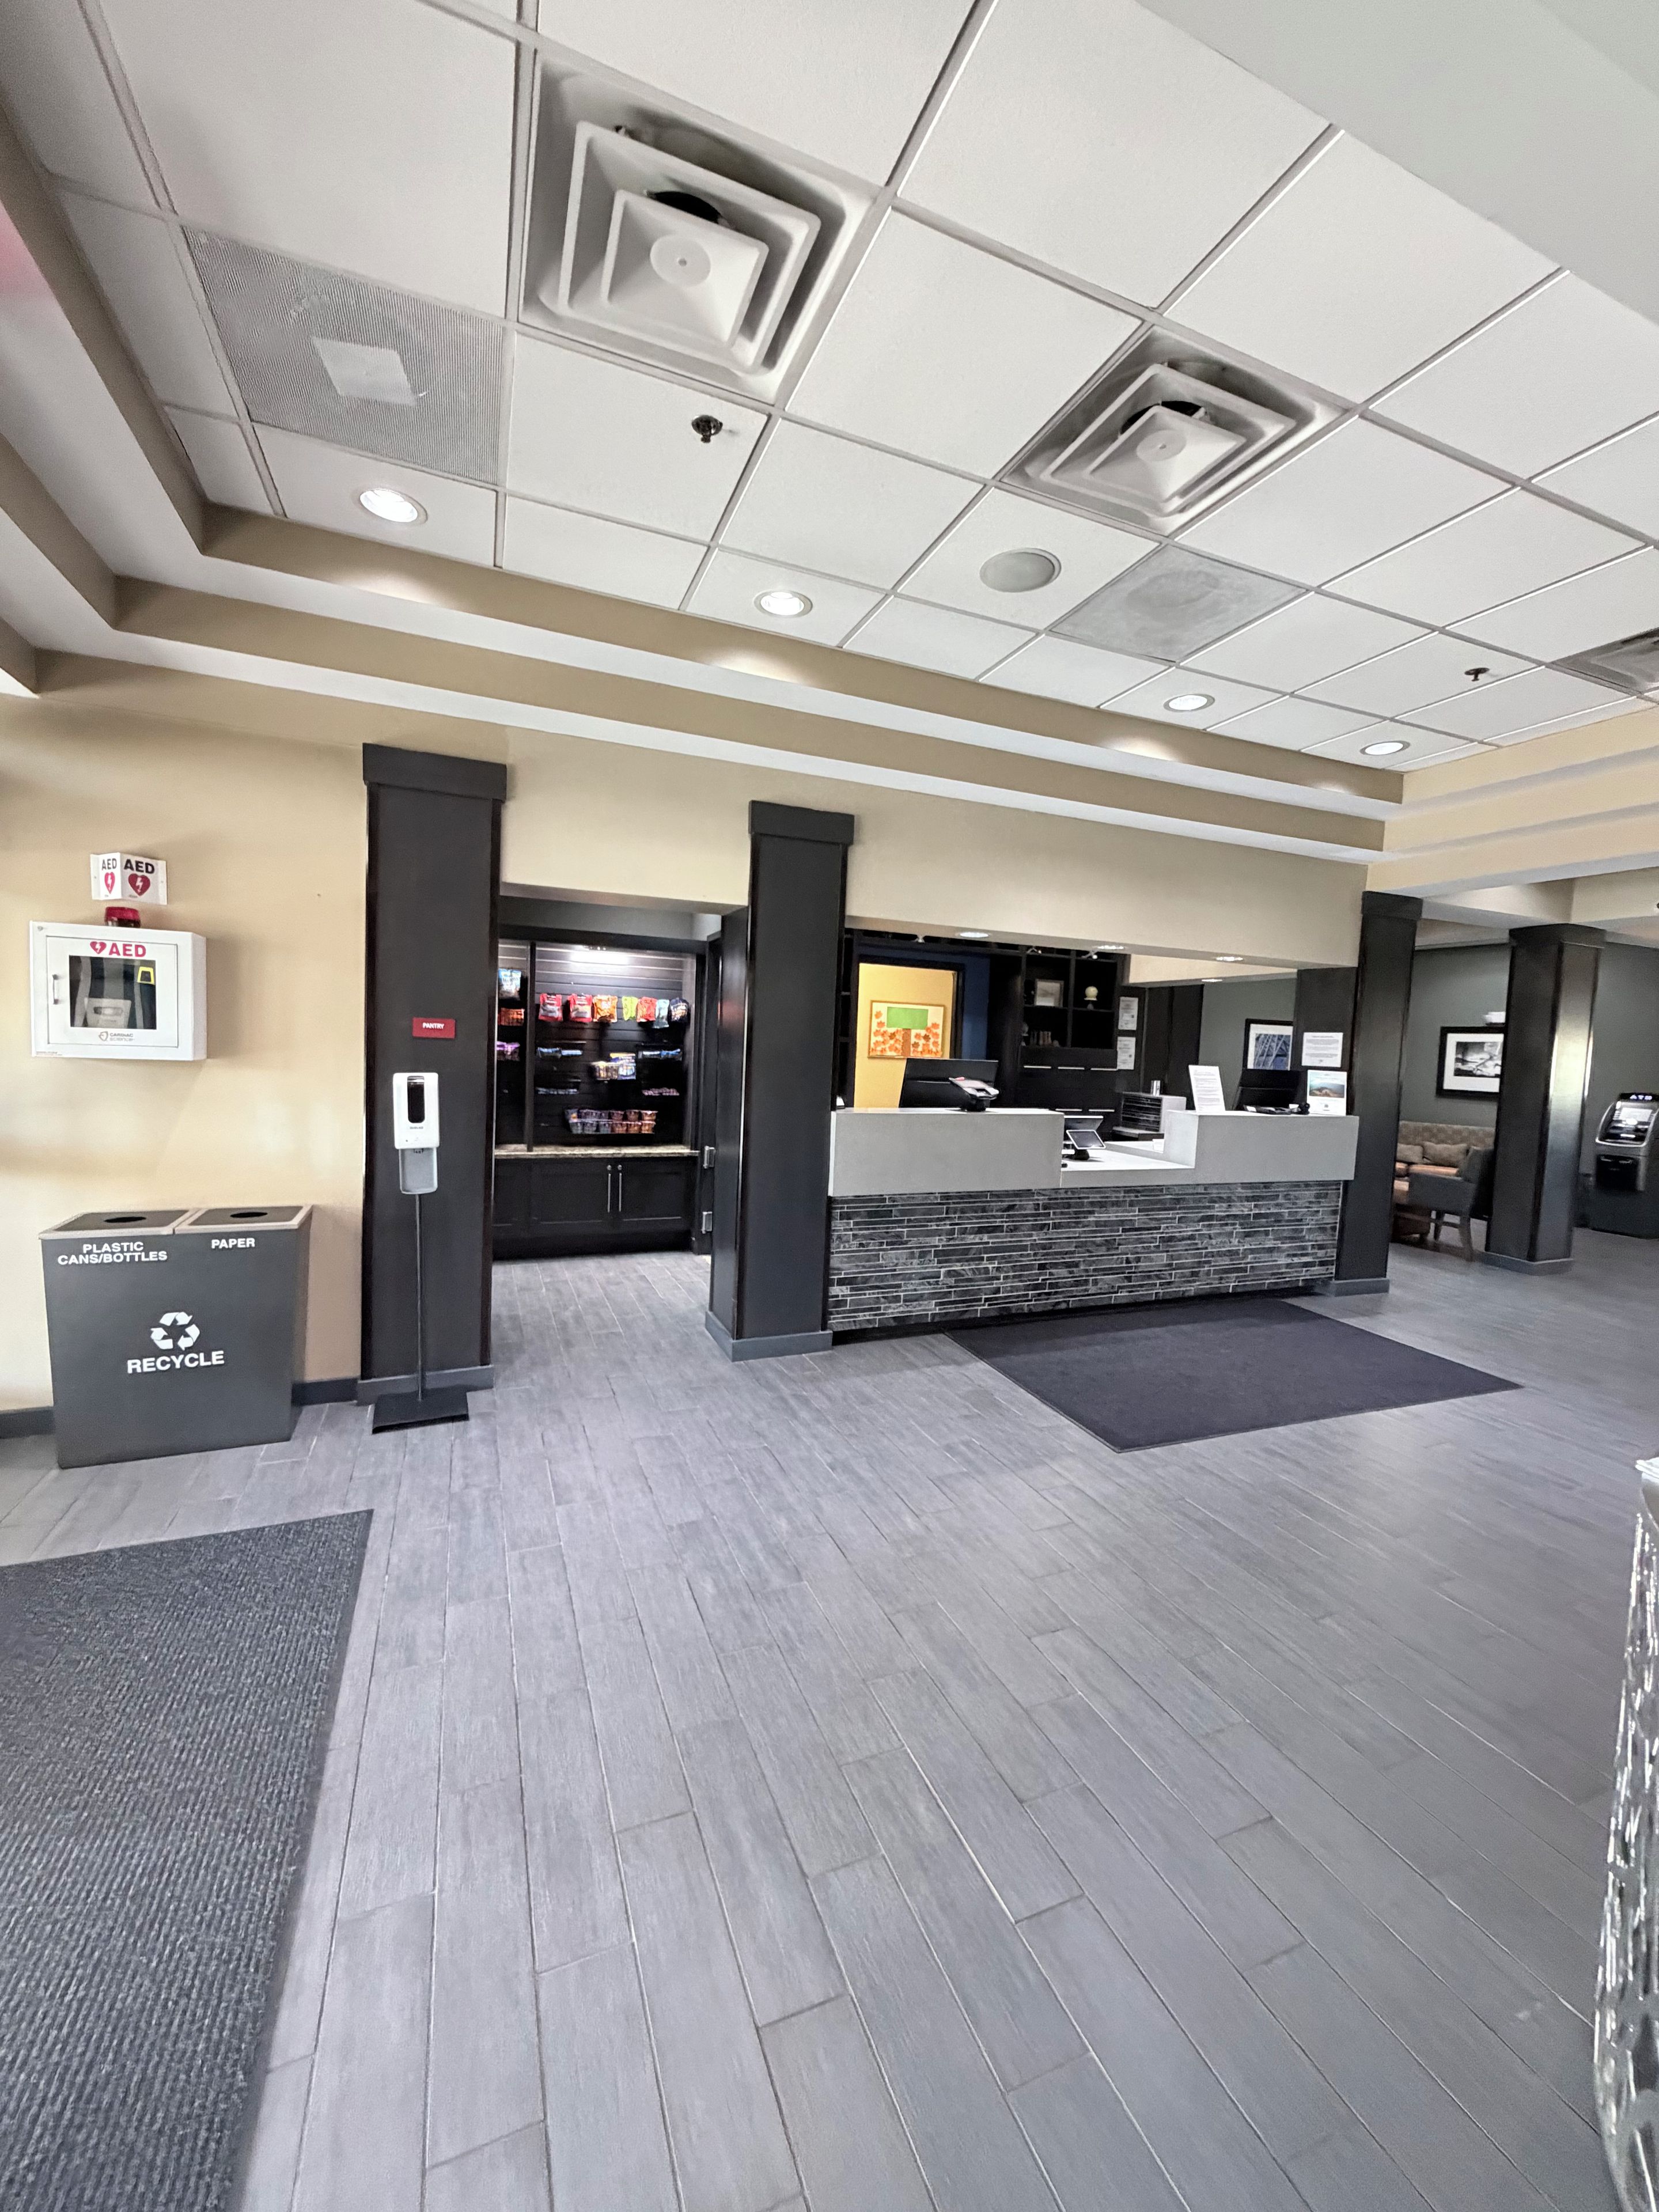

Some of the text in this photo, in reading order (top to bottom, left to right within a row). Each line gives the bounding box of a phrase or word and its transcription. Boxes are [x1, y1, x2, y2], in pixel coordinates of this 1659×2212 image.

[102, 858, 117, 870] AED
[124, 858, 155, 874] AED
[108, 942, 146, 957] AED
[82, 1241, 144, 1253] PLASTIC
[211, 1237, 255, 1249] PAPER
[58, 1251, 168, 1265] CANS/BOTTLES
[127, 1350, 225, 1374] RECYCLE
